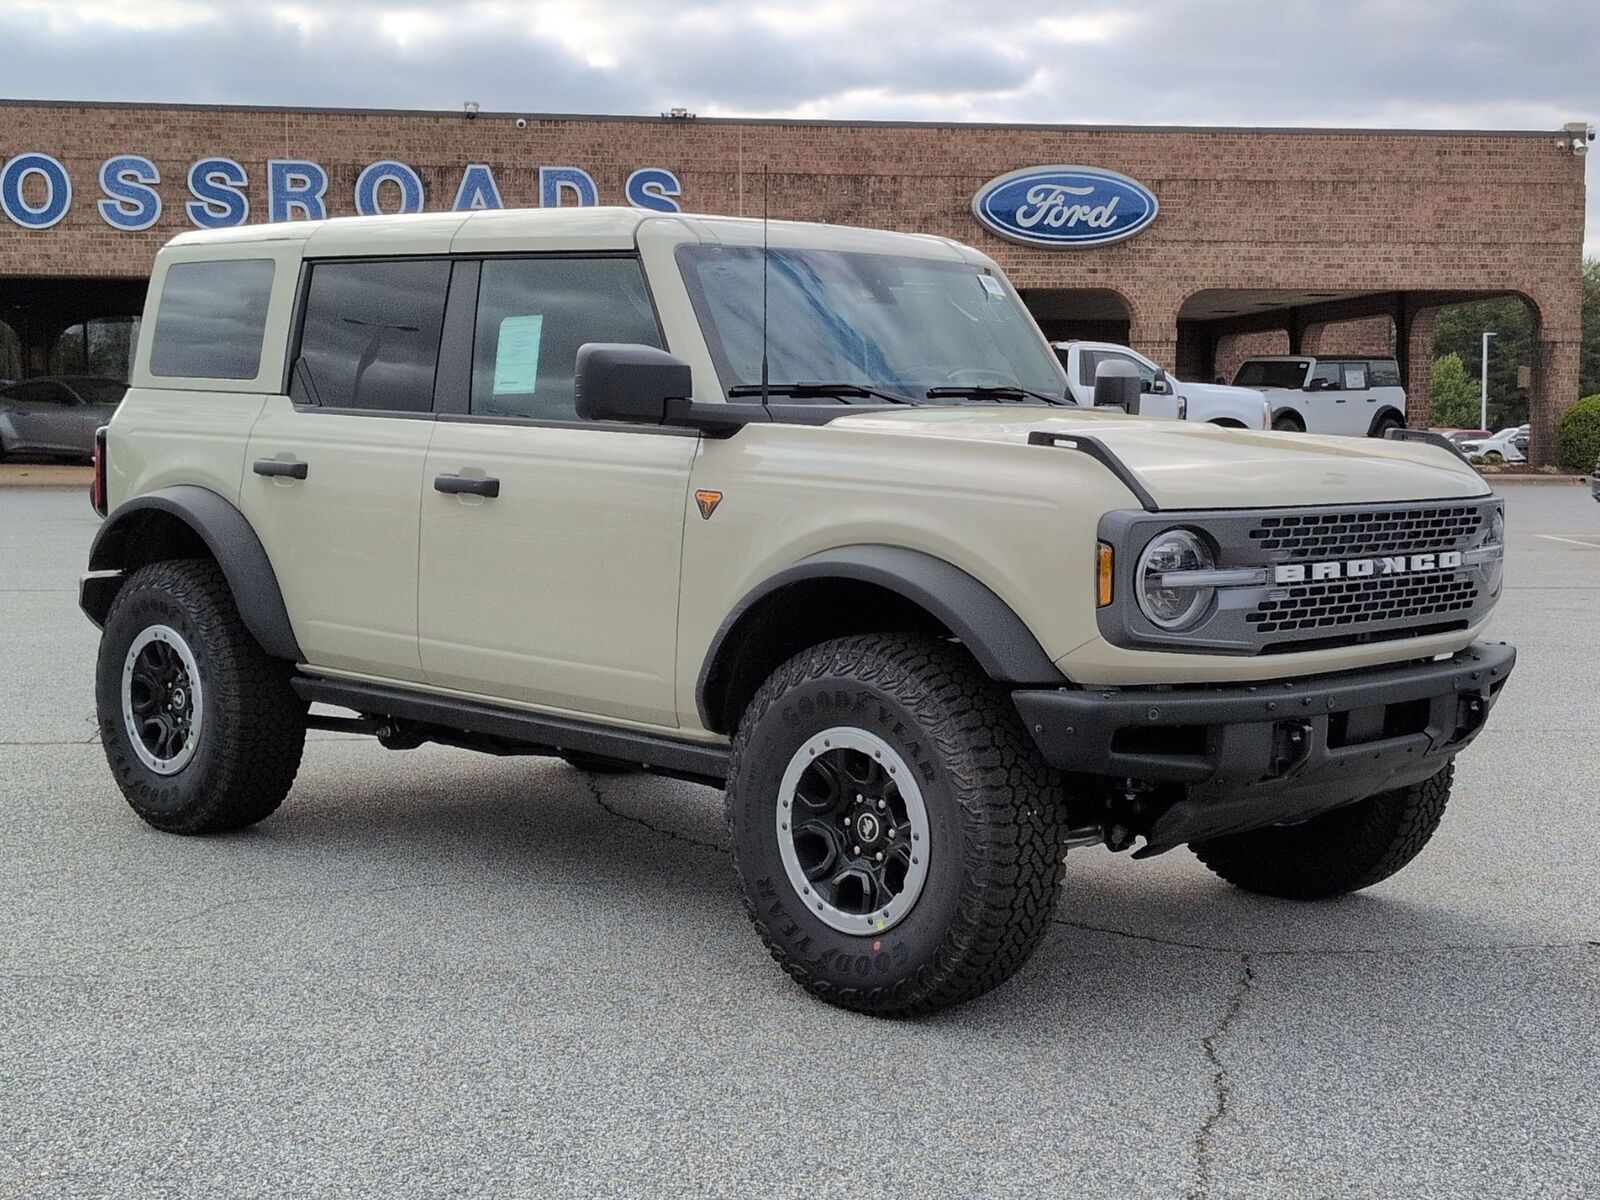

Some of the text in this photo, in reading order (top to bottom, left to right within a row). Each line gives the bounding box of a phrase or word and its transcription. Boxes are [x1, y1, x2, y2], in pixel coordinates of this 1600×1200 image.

[0, 152, 682, 230] OSSROADS
[1016, 184, 1120, 228] Ford
[1275, 552, 1461, 583] BRONCO
